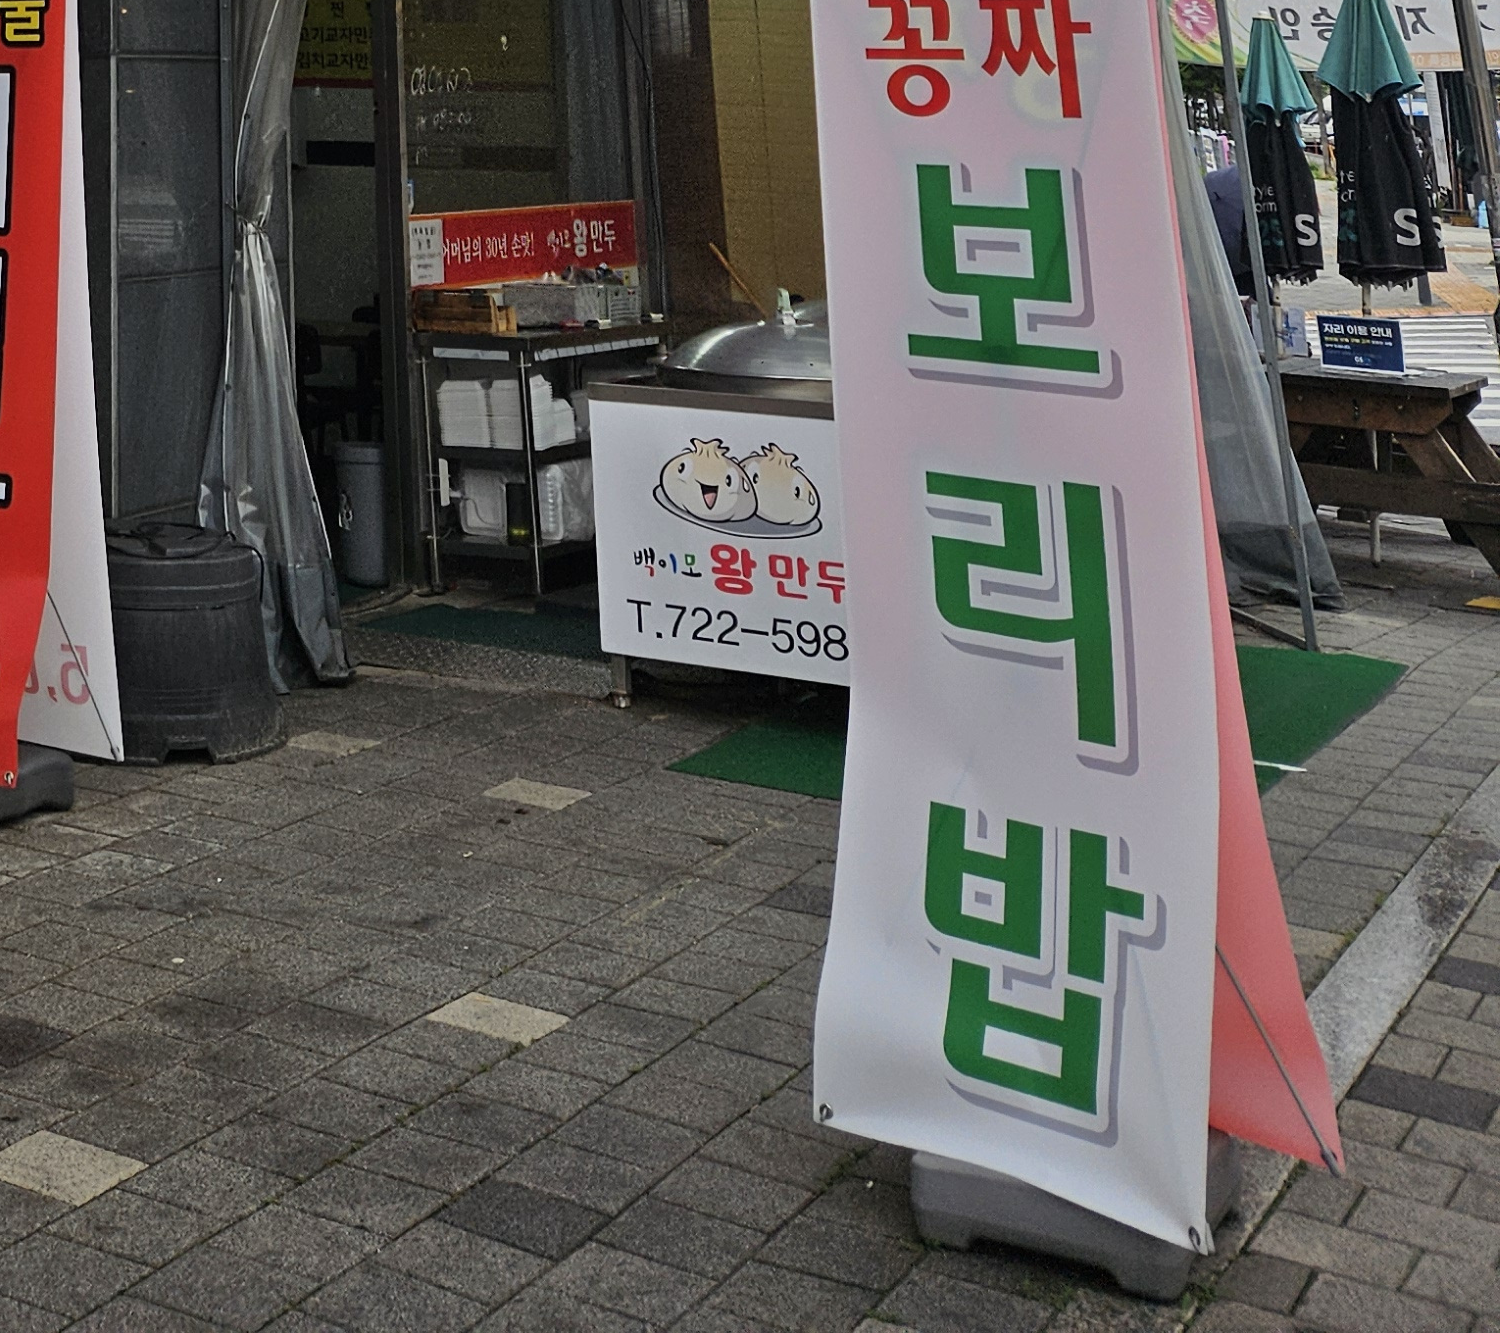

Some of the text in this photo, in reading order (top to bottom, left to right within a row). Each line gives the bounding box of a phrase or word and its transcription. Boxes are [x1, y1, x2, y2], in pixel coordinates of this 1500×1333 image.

[300, 27, 372, 44] 고기교자만
[298, 53, 370, 71] 김치교자만
[486, 233, 508, 259] 30년
[573, 218, 616, 258] 왕만두
[1323, 323, 1393, 338] 자리 이용 안내
[633, 543, 846, 604] 백이모 왕만두
[908, 161, 1156, 1133] 보리밥
